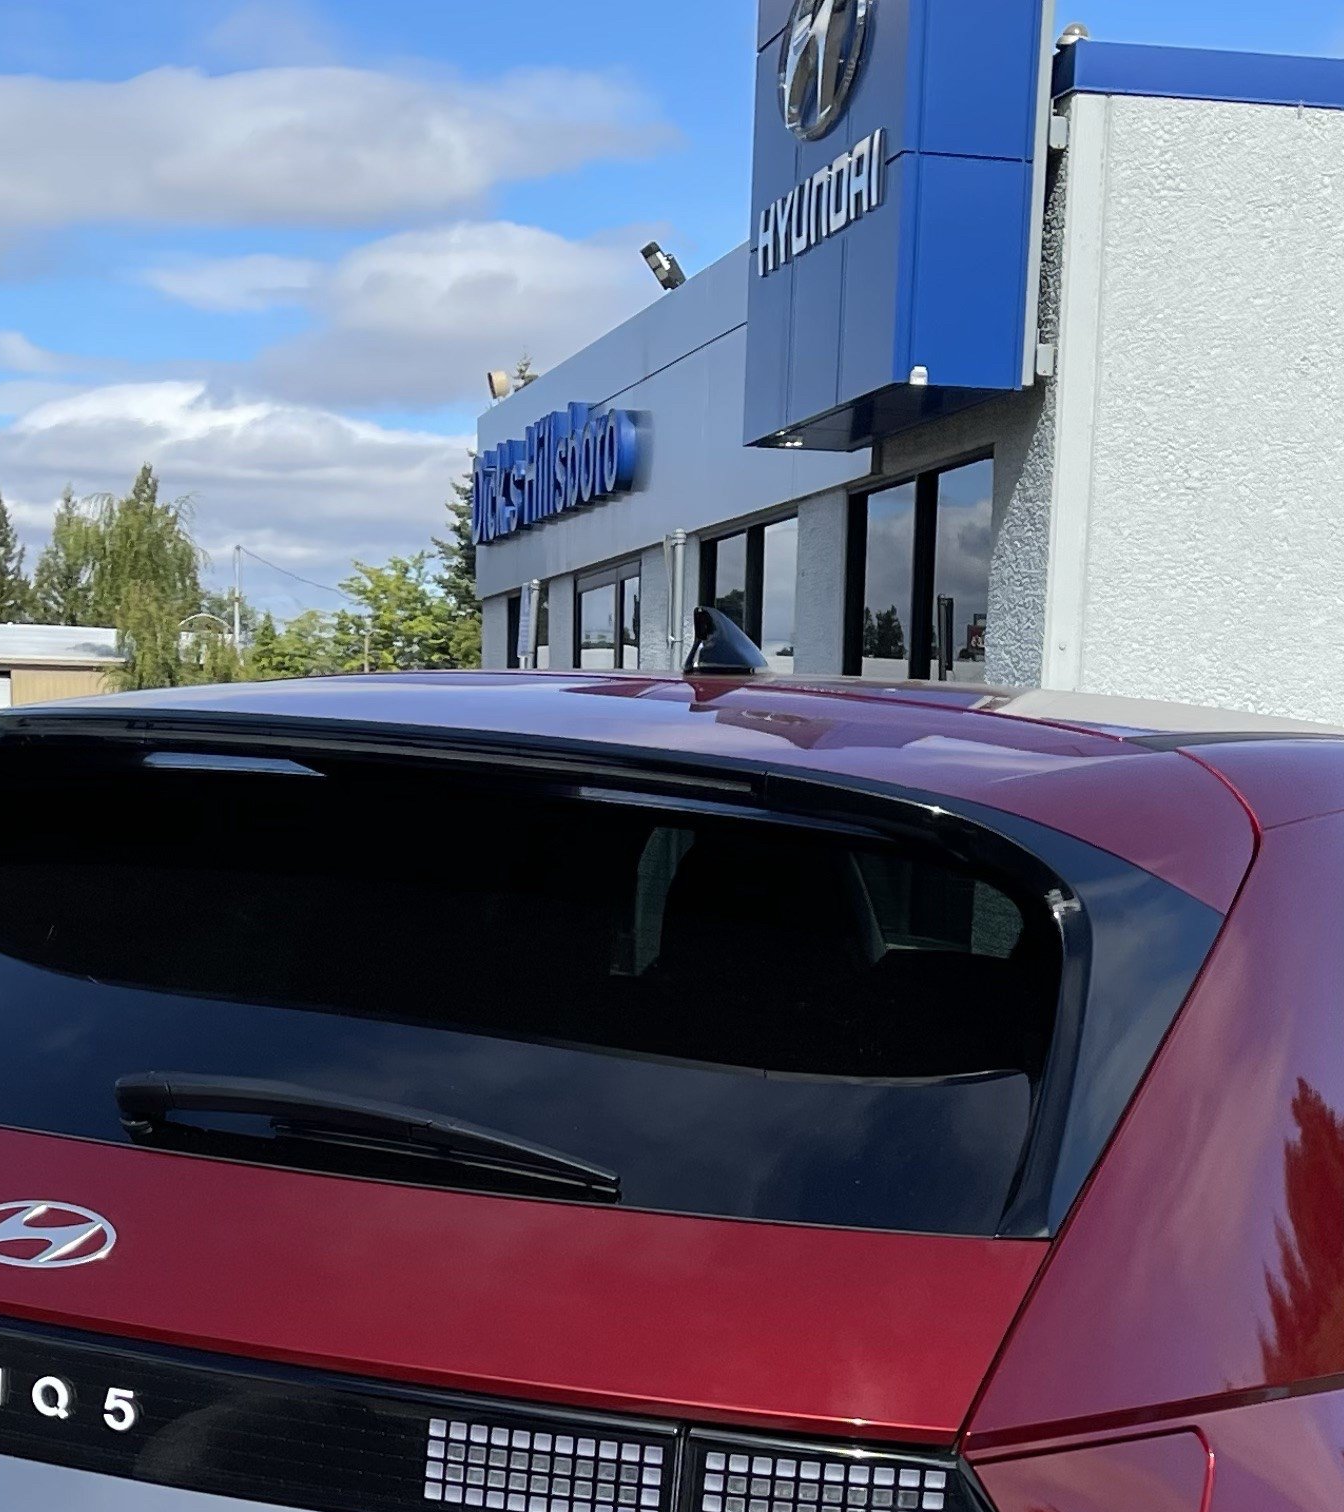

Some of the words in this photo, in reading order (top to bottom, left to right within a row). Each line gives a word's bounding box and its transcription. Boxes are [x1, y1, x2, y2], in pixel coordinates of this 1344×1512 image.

[758, 127, 885, 277] HYUNDAI
[524, 402, 632, 524] Hillsboro
[103, 1387, 140, 1431] 5
